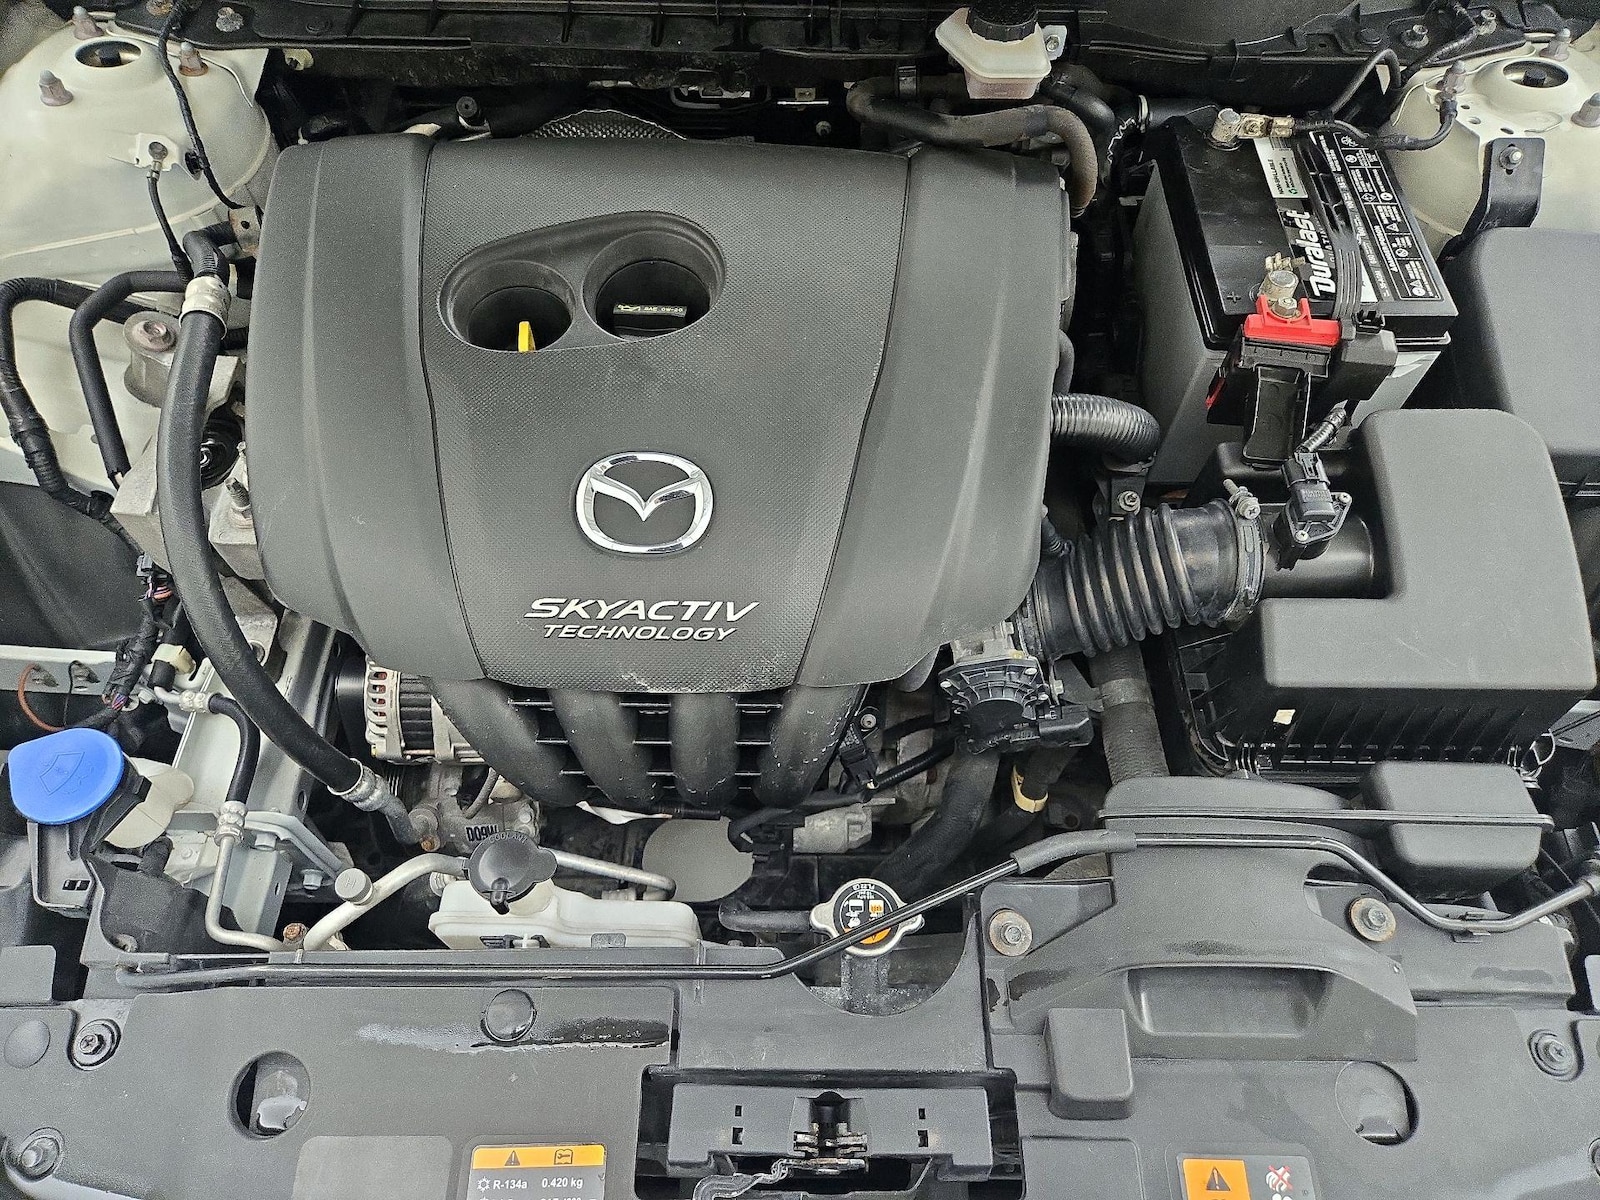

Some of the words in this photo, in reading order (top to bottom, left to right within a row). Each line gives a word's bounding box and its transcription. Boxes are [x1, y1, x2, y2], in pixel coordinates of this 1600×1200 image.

[1286, 209, 1336, 297] Duralast
[523, 597, 760, 622] SKYACTIV
[543, 624, 737, 641] TECHNOLOGY
[489, 831, 528, 845] COOLANT
[492, 1179, 528, 1190] R-134a
[541, 1177, 568, 1188] 0.420
[570, 1177, 584, 1188] kg
